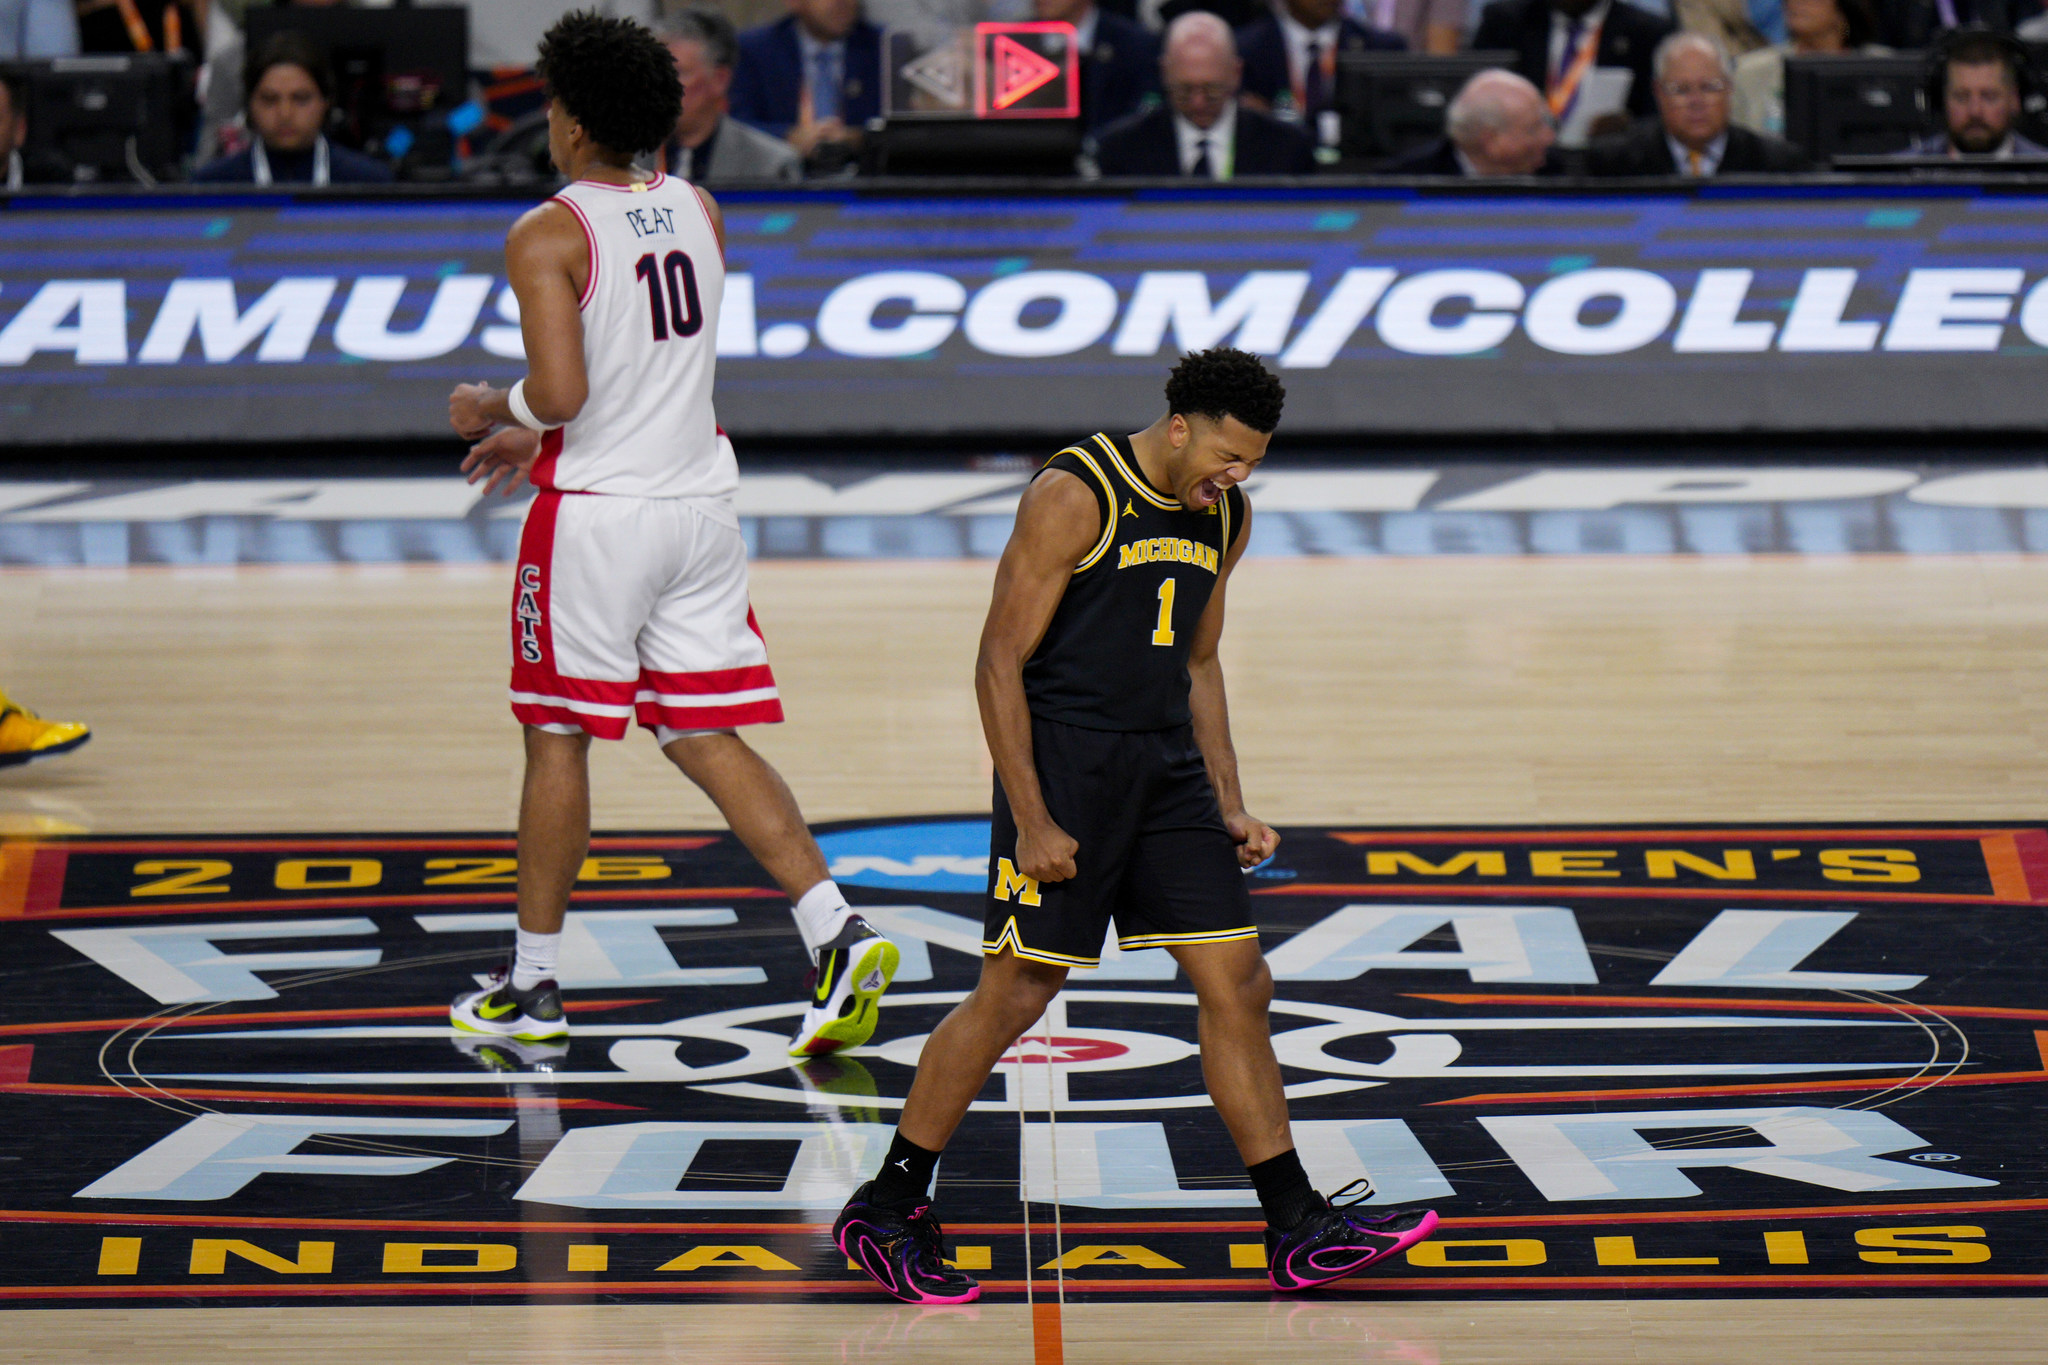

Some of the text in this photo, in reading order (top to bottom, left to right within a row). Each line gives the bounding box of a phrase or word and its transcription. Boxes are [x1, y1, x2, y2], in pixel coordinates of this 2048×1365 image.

[626, 207, 675, 238] PEAT
[635, 249, 704, 342] 10
[1117, 537, 1219, 575] MICHIGAN
[517, 564, 542, 663] CATS
[1152, 577, 1176, 647] 1
[130, 848, 1921, 897] 2026 MEN'S
[994, 856, 1042, 907] M
[72, 1105, 2001, 1210] FOUR
[97, 1225, 1993, 1275] INDIAAOLIS
